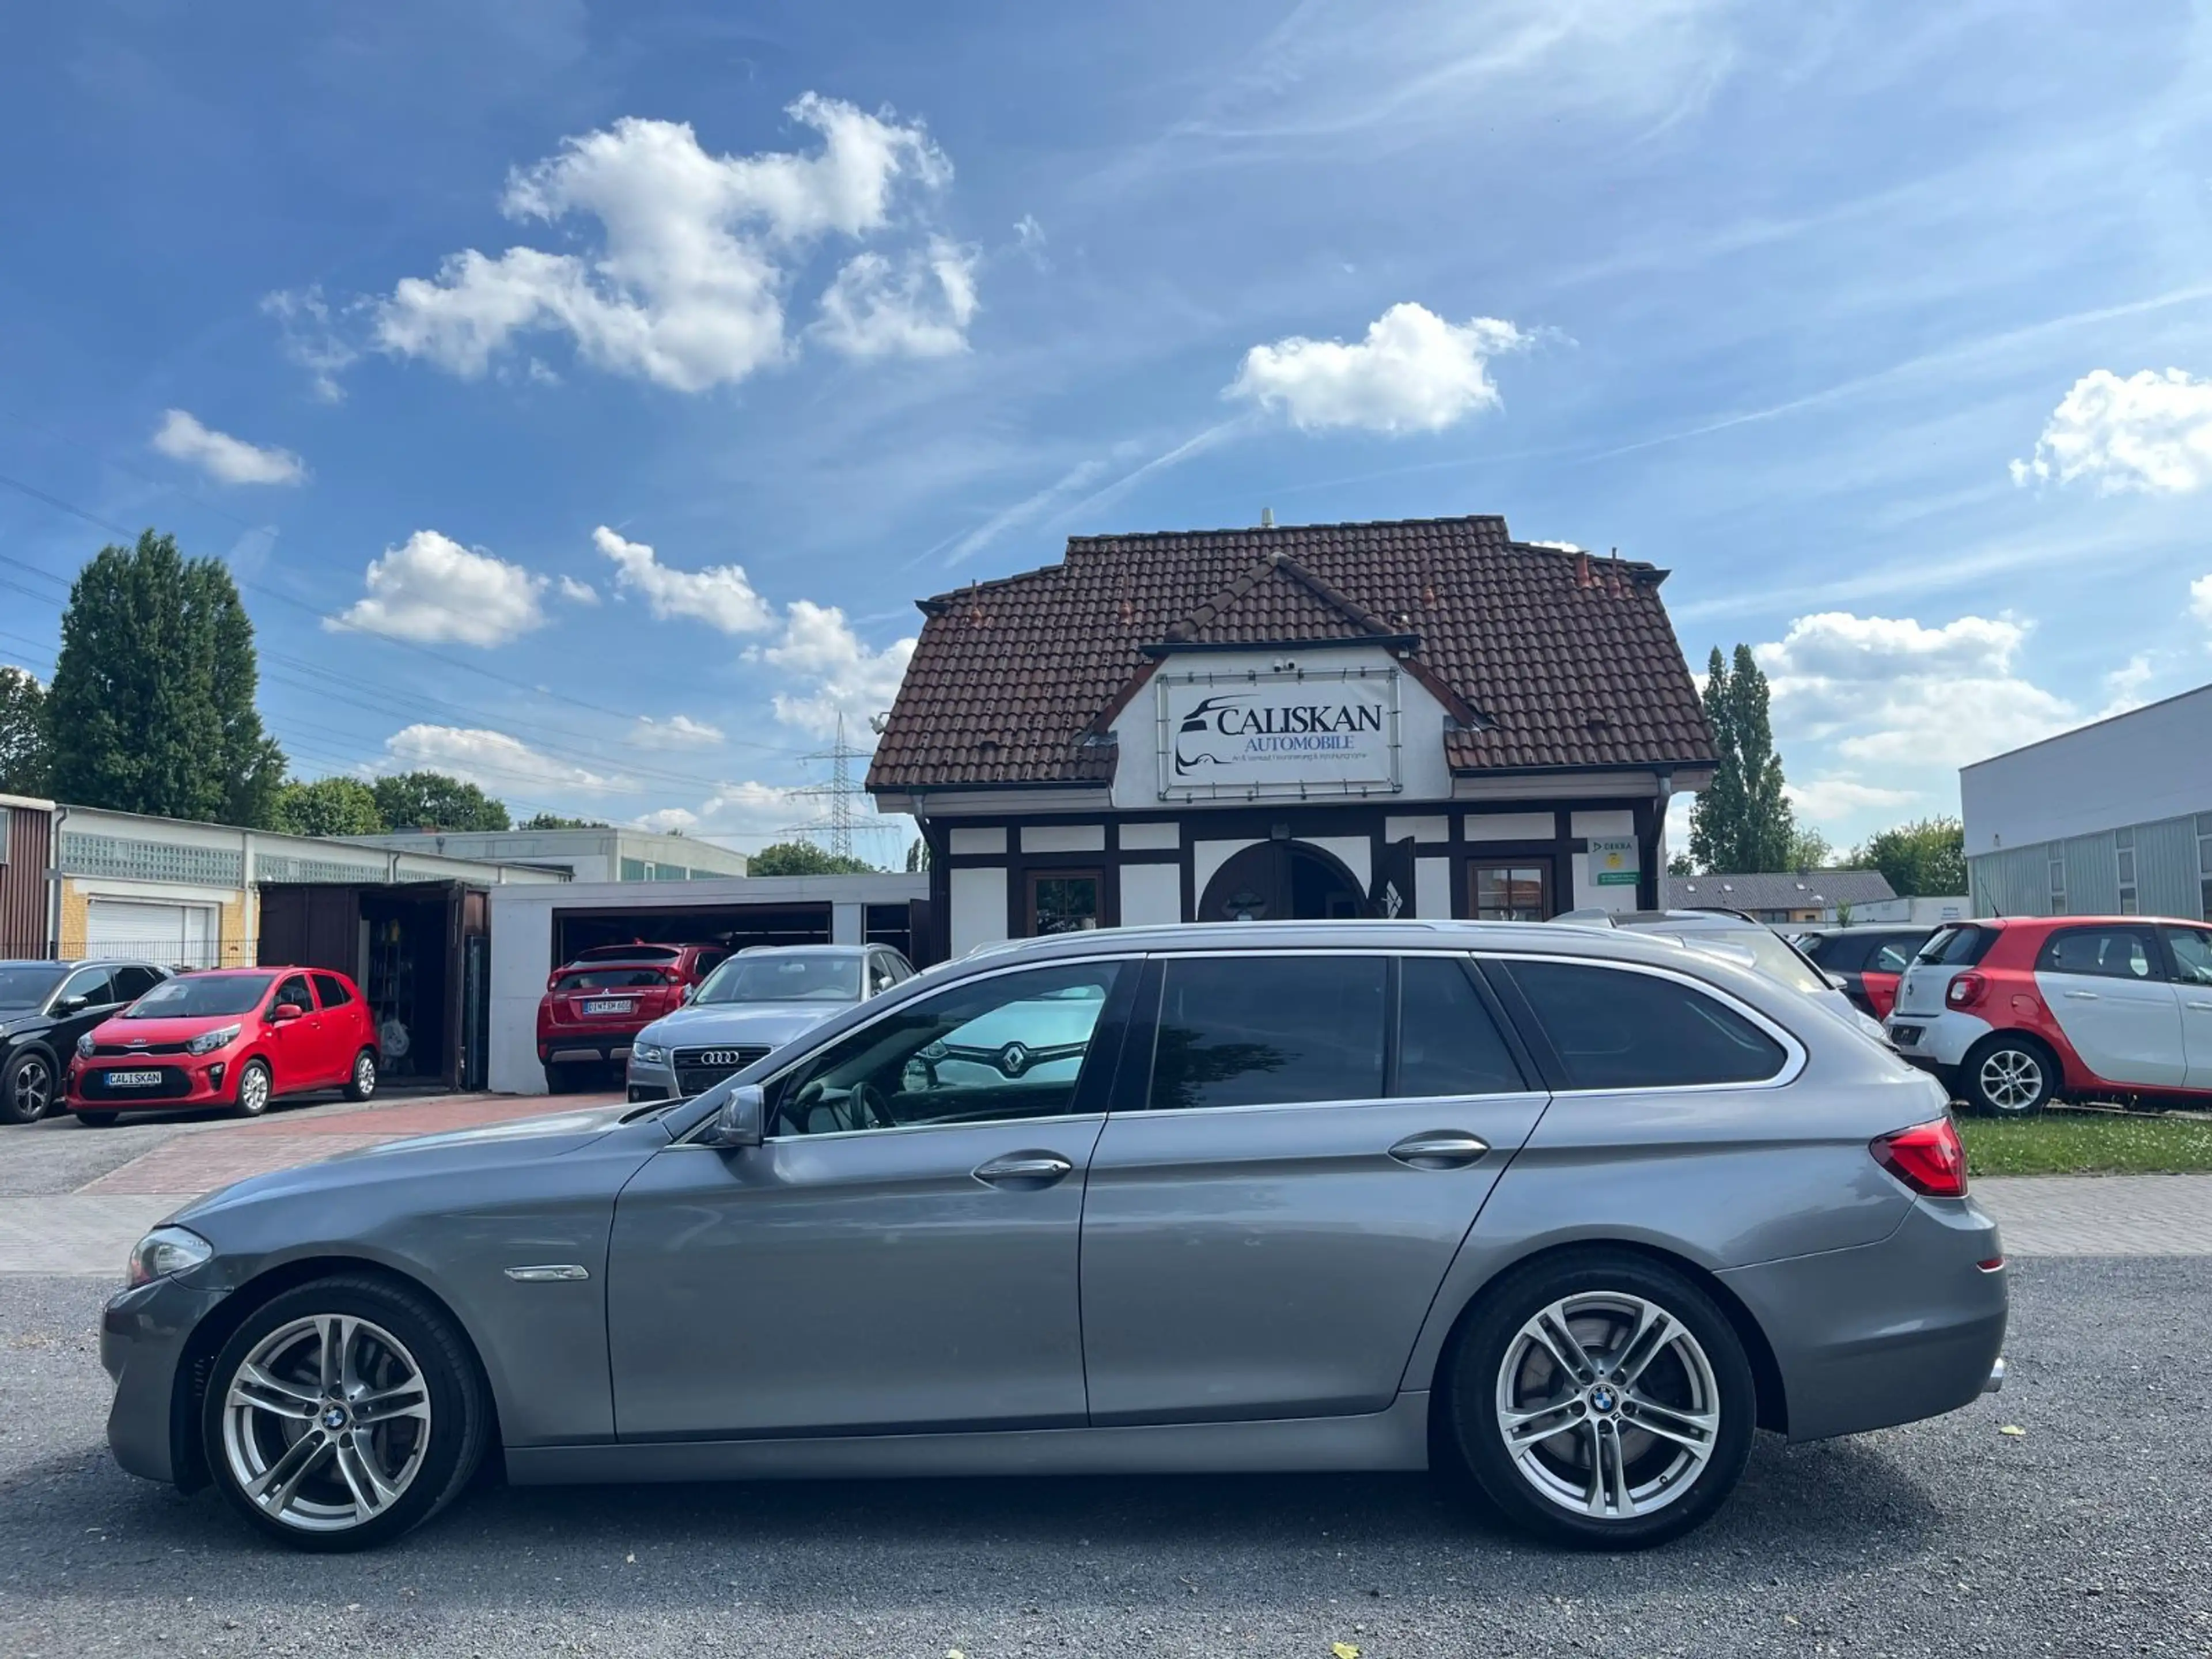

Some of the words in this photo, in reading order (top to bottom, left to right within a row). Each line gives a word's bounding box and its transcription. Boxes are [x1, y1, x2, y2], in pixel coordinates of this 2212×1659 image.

[1217, 705, 1382, 736] CALISKAN
[1245, 735, 1355, 752] AUTOMOBILE
[110, 1073, 160, 1084] CALISKAN
